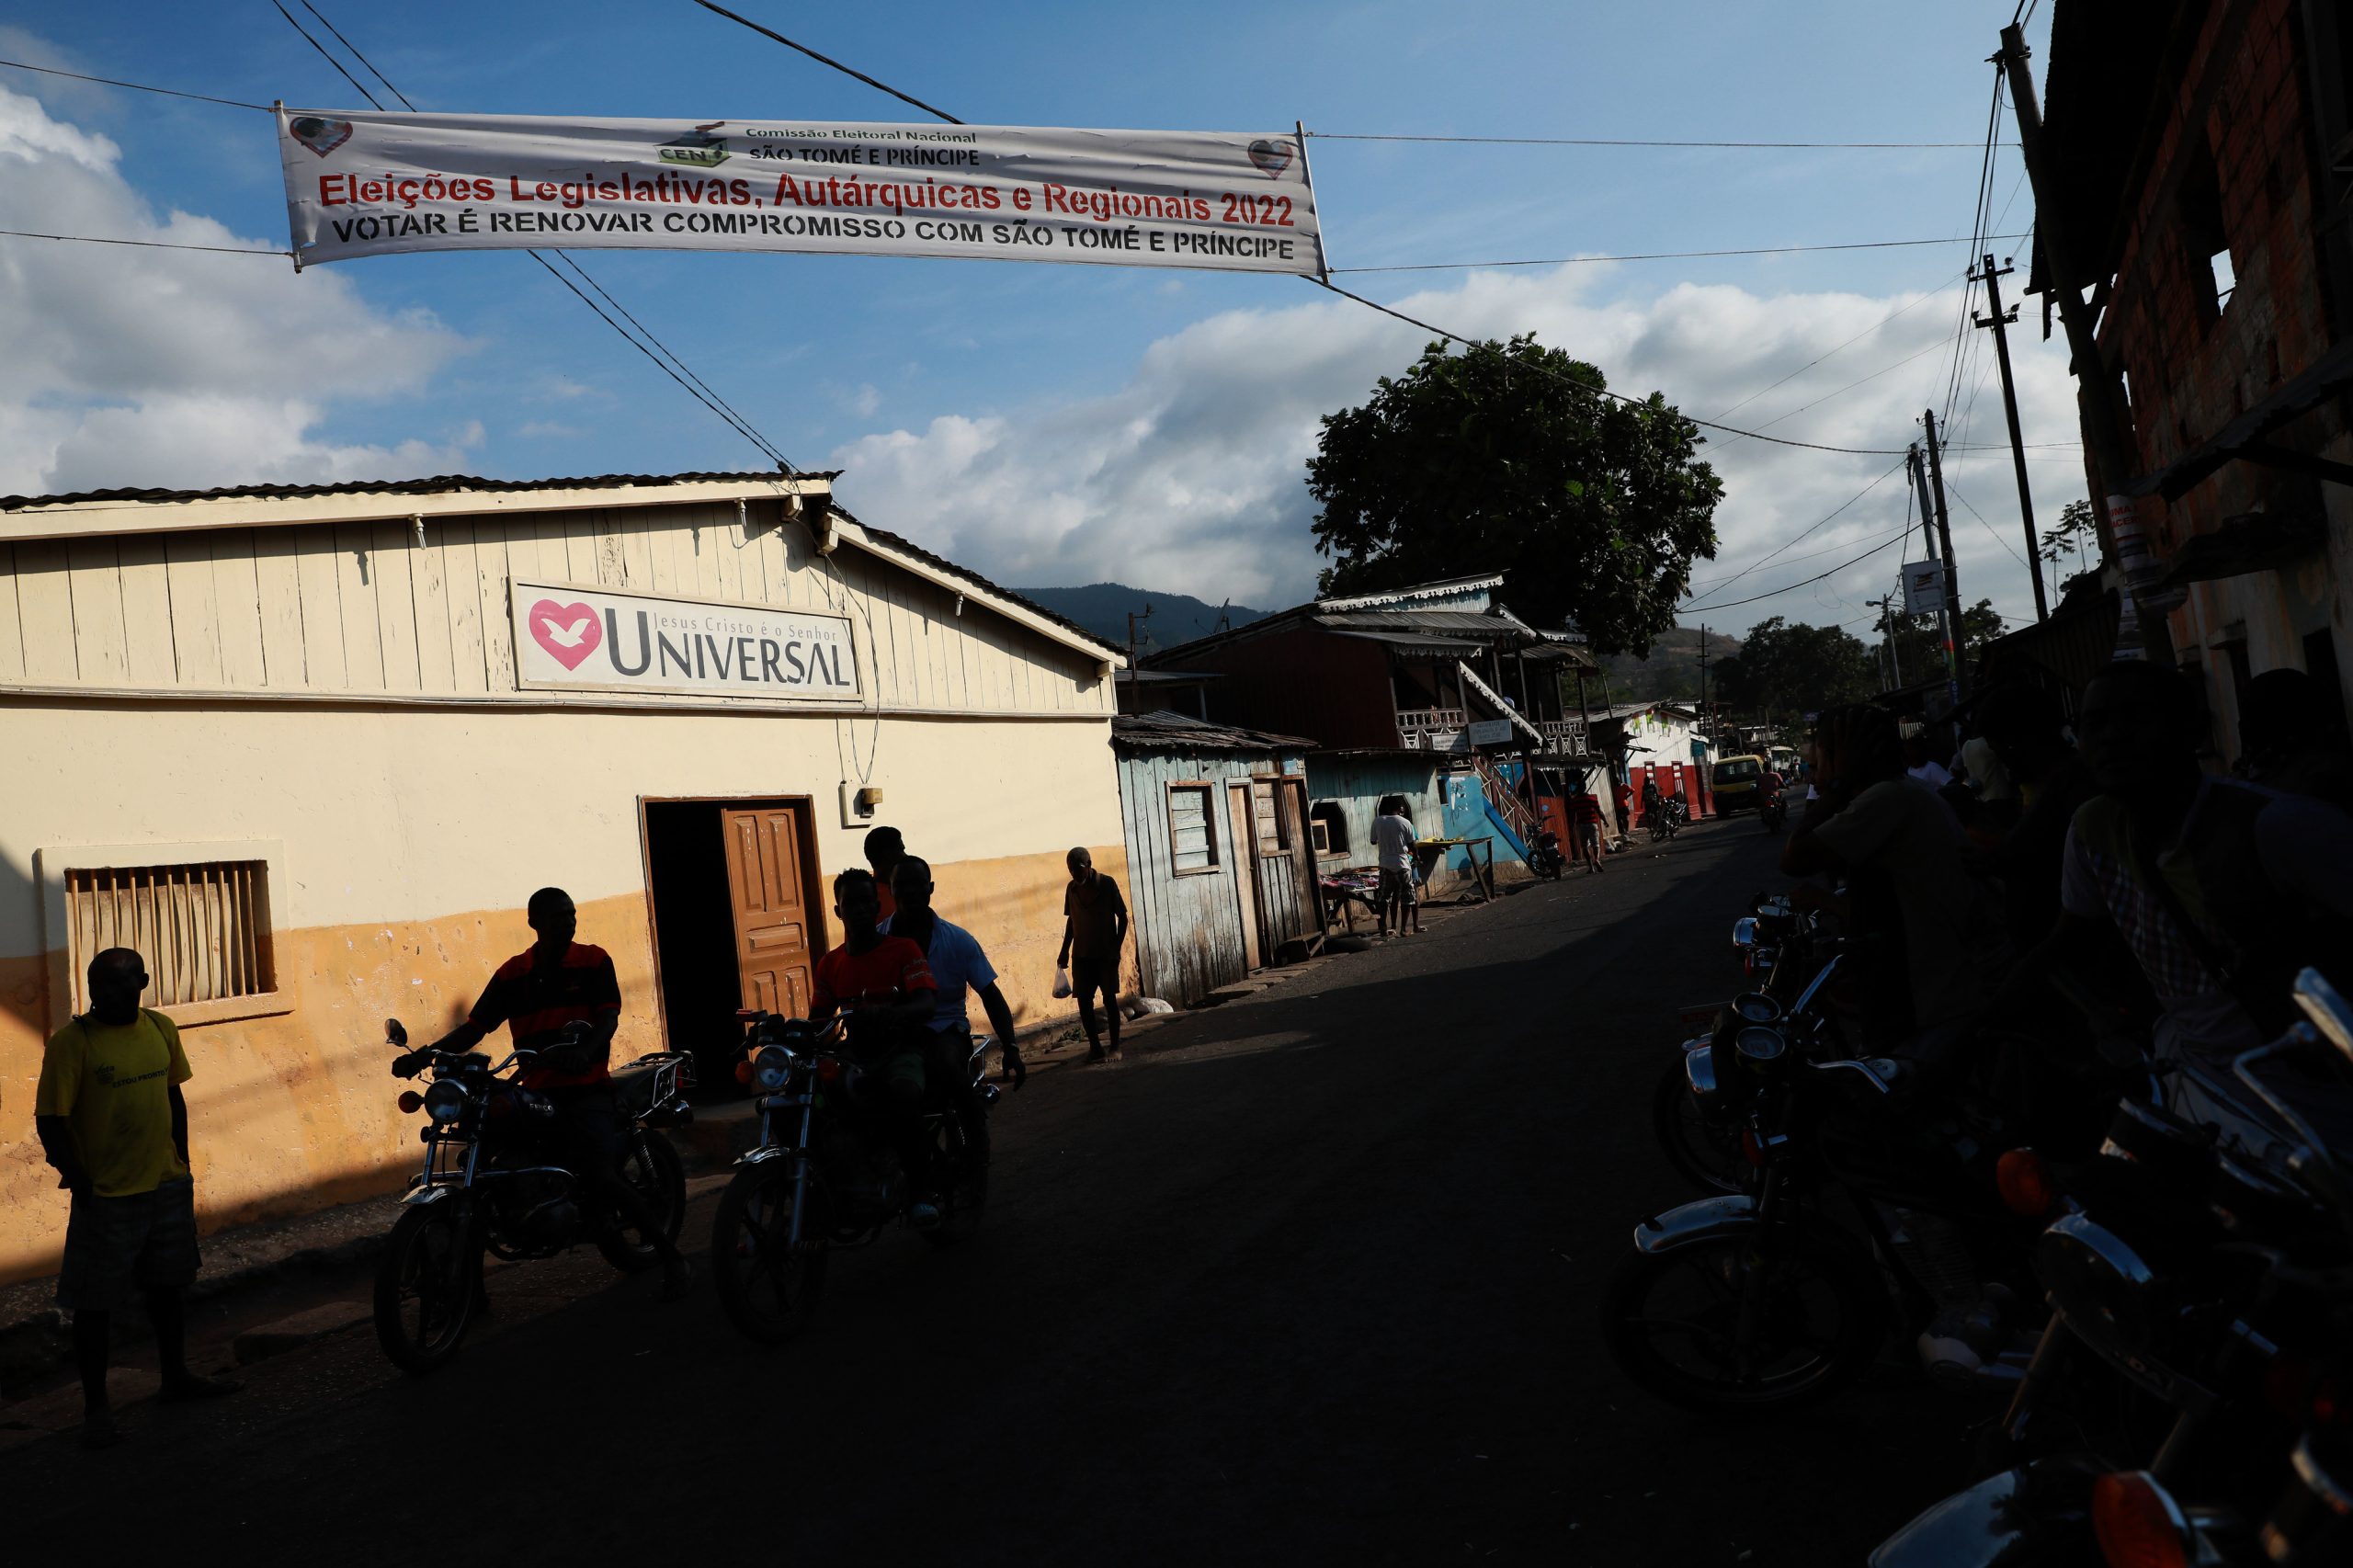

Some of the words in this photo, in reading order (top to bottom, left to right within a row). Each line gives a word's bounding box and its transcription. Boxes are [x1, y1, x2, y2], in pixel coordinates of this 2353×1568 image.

[745, 128, 827, 139] Comissão
[832, 129, 901, 140] Eleitoral
[905, 131, 977, 143] Nacional
[660, 148, 707, 162] CEN
[749, 144, 793, 161] SÃO
[799, 147, 863, 165] TOMÉ
[869, 149, 881, 165] E
[886, 144, 981, 166] PRÍNCIPE
[319, 174, 496, 210] Eleições
[510, 171, 763, 210] Legislativas,
[774, 173, 1002, 217] Autárquicas
[1012, 187, 1032, 211] e
[1043, 181, 1211, 222] Regionais
[1220, 192, 1295, 227] 2022
[332, 212, 449, 243] VOTAR
[458, 208, 480, 233] É
[490, 211, 654, 233] RENOVAR
[662, 210, 906, 240] COMPROMISSO
[917, 221, 984, 243] COM
[992, 218, 1054, 246] SÃO
[1061, 224, 1142, 250] TOMÉ
[1149, 231, 1166, 252] E
[1173, 230, 1295, 260] PRÍNCIPE
[654, 612, 698, 630] Jesus
[705, 617, 754, 634] Cristo
[761, 621, 767, 635] é
[775, 627, 782, 636] o
[789, 624, 837, 642] Senhor
[604, 607, 851, 687] UNIVERSAL
